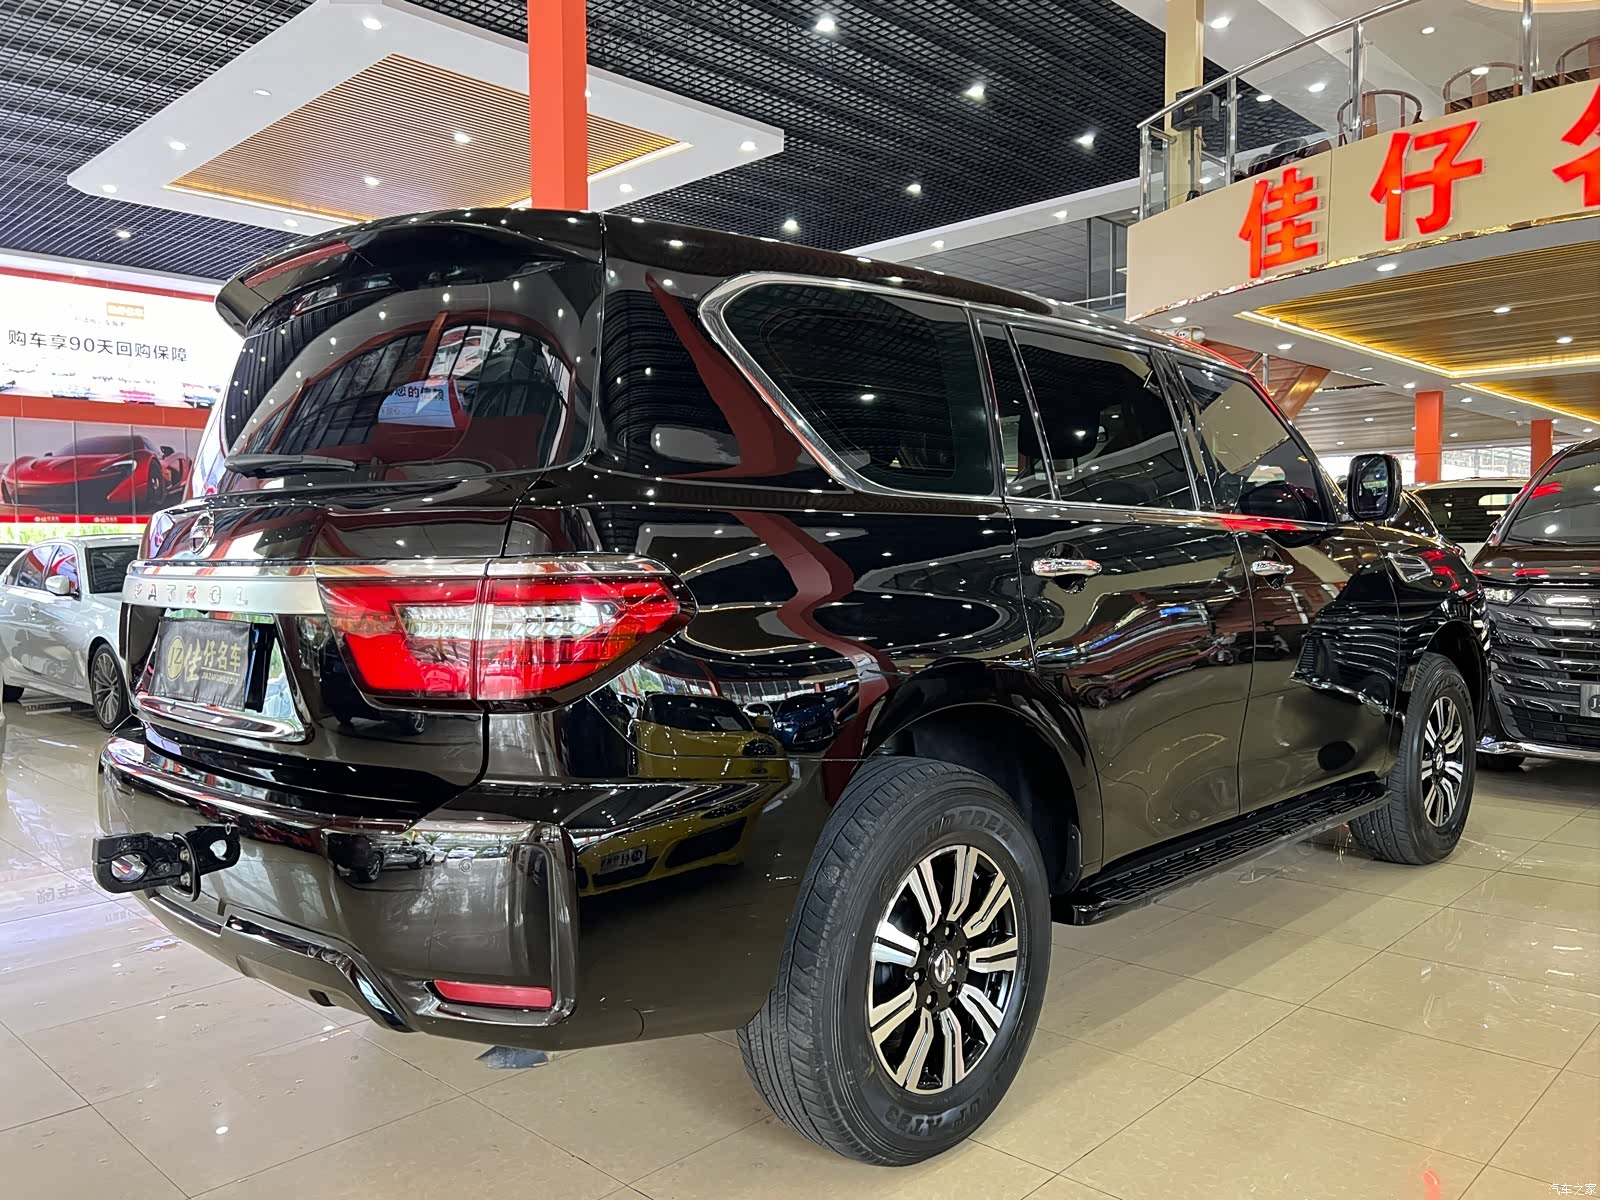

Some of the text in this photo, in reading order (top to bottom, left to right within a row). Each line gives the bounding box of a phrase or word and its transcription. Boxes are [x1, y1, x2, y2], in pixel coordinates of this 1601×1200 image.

[8, 329, 188, 362] 购车享90天回购保障
[134, 583, 249, 606] PATROL
[184, 638, 241, 682] 佳仔名车
